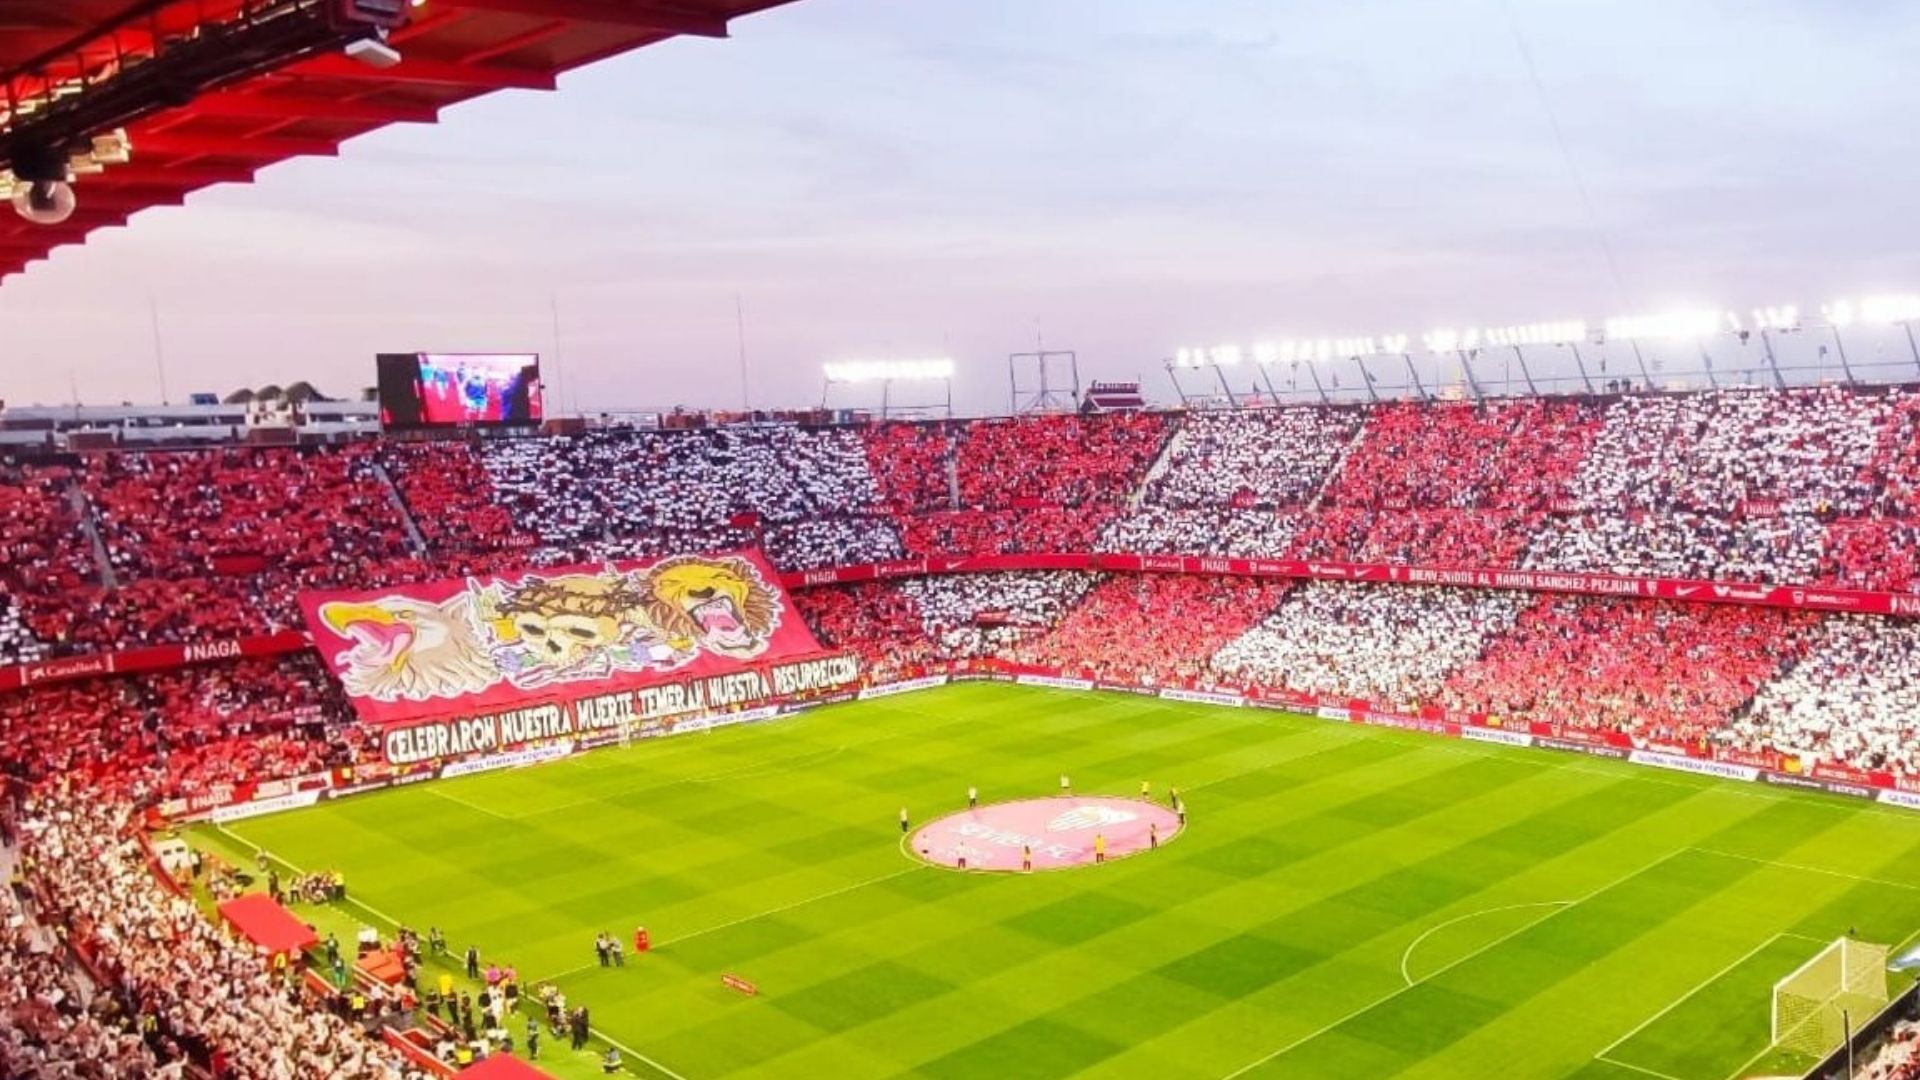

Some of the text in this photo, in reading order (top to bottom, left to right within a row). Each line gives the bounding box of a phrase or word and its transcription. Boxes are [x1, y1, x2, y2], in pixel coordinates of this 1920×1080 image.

[1478, 572, 1491, 585] AL
[193, 640, 242, 661] NAGA
[387, 716, 496, 765] CELEBRARON
[500, 703, 572, 744] NUESTRA
[576, 691, 633, 731] MUERTE
[708, 671, 771, 707] NUESTRA
